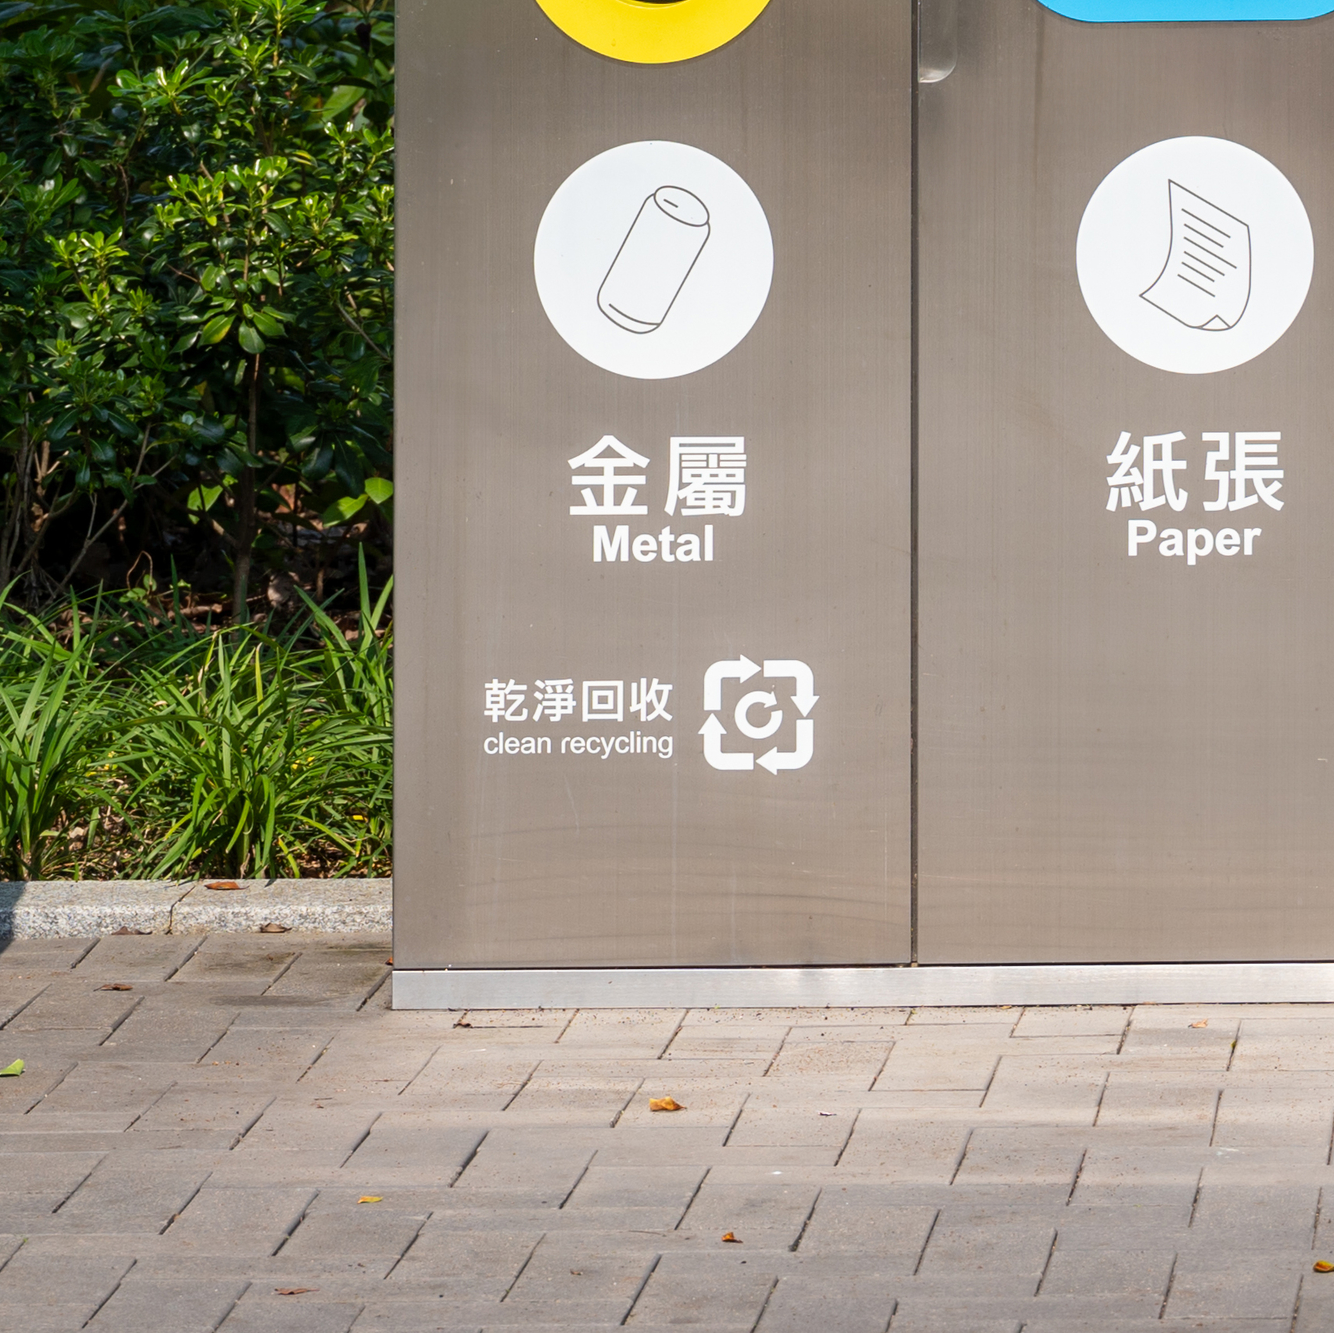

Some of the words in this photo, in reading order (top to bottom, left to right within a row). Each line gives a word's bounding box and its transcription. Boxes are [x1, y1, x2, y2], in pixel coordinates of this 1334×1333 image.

[567, 434, 747, 517] 金屬
[1105, 430, 1285, 512] 紙張
[593, 524, 714, 563] Metal
[1127, 519, 1263, 566] Paper
[483, 677, 673, 723] 乾淨回收
[483, 731, 552, 755] clean
[561, 730, 673, 760] recycling
